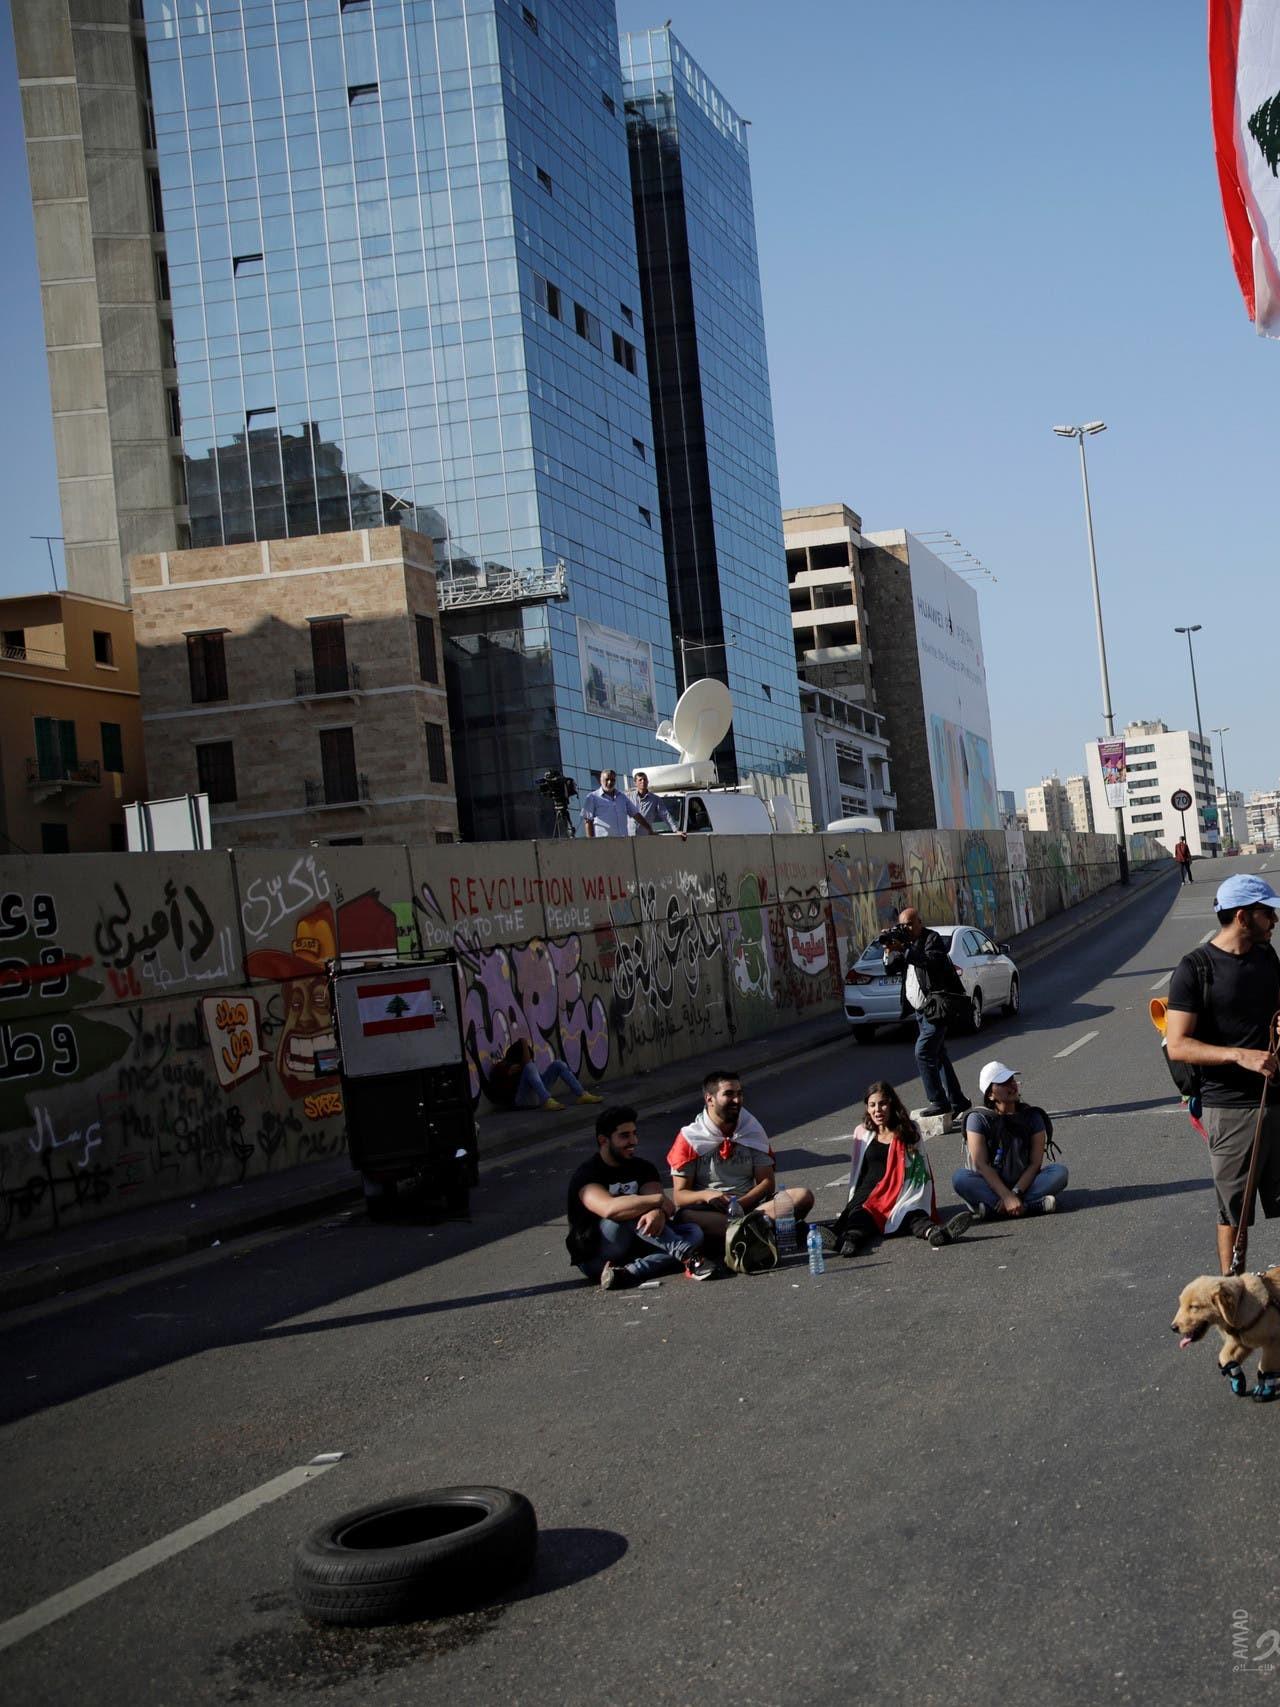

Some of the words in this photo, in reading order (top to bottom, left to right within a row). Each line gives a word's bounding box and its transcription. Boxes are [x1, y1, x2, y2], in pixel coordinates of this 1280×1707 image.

[1175, 796, 1188, 806] 70
[450, 876, 575, 920] REVOLUTION
[582, 876, 627, 901] WALL
[474, 916, 492, 937] TO
[494, 908, 525, 933] THE
[547, 907, 592, 929] PEOPLE
